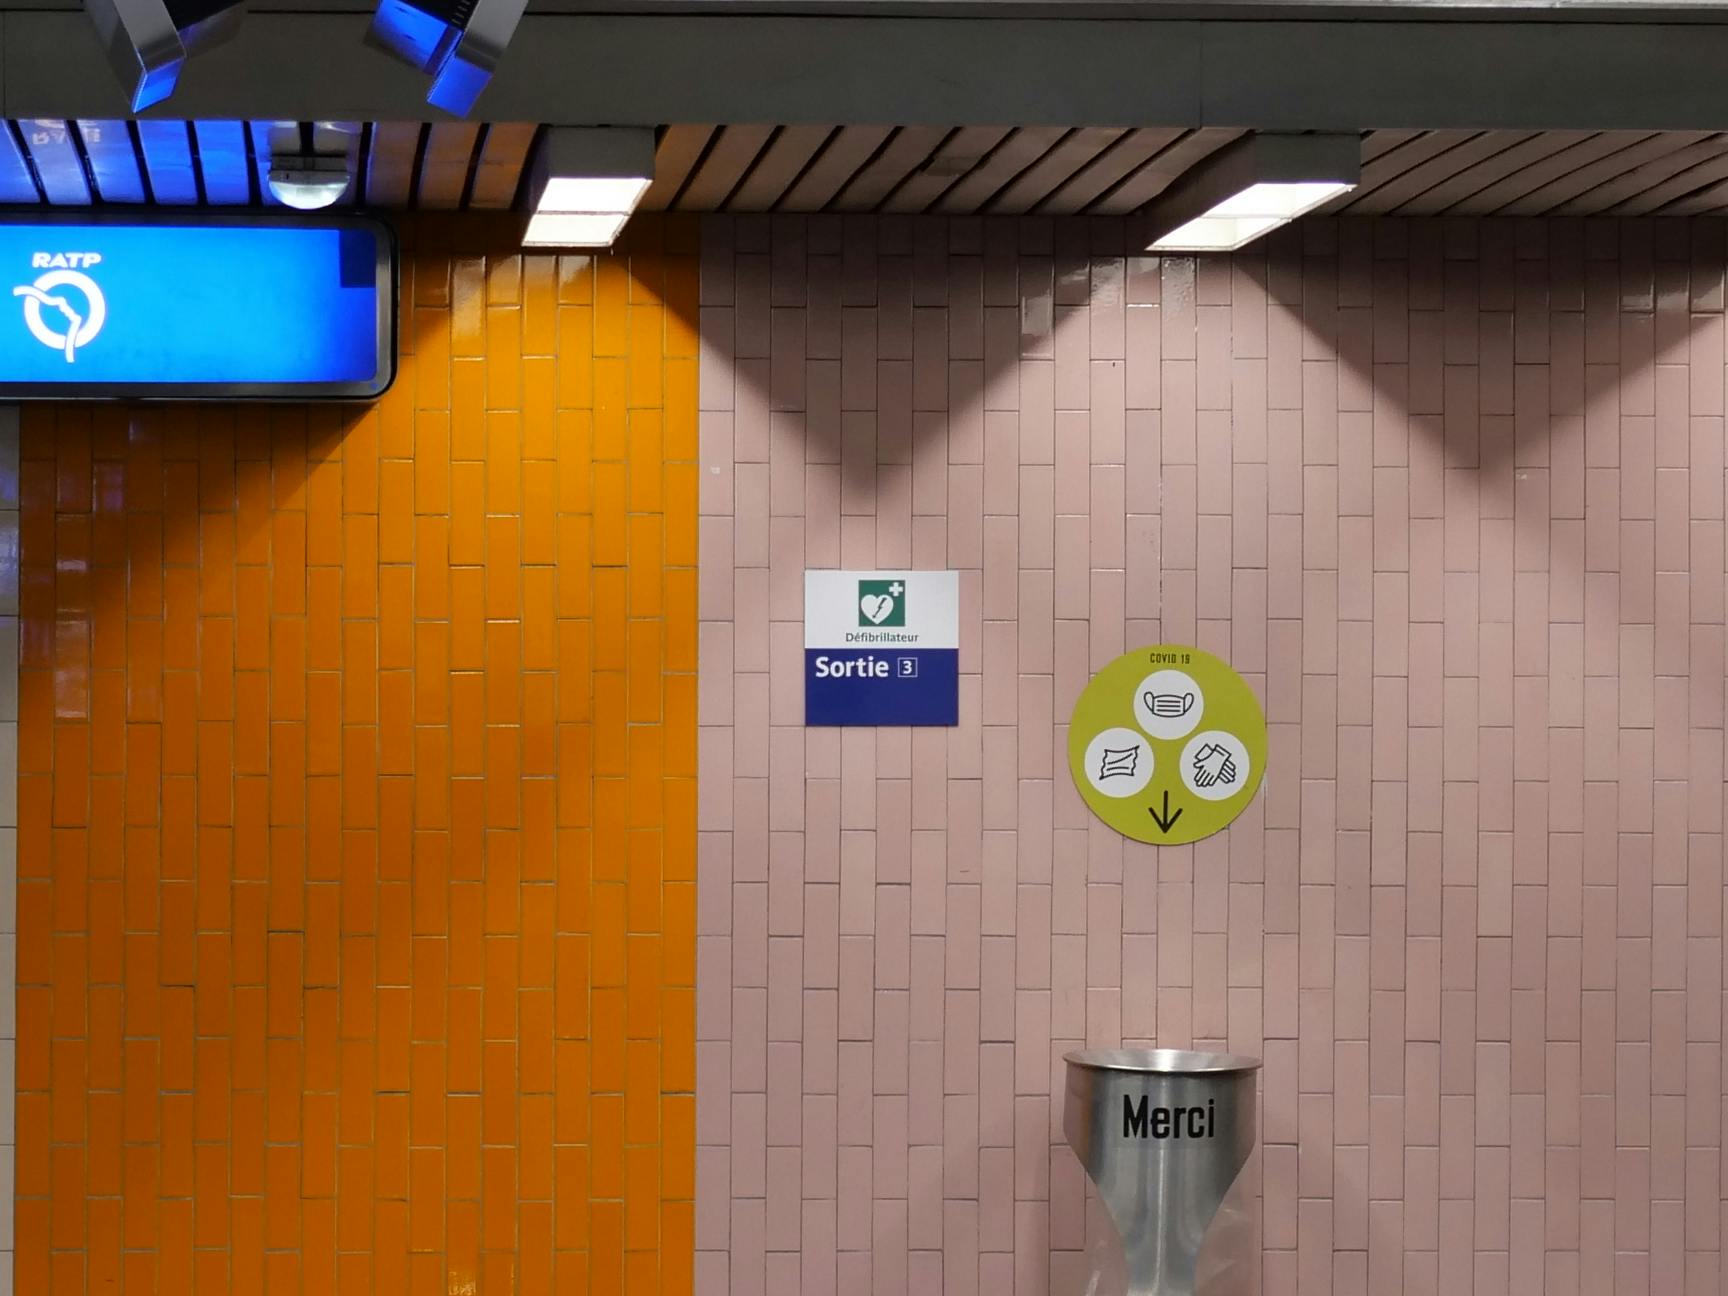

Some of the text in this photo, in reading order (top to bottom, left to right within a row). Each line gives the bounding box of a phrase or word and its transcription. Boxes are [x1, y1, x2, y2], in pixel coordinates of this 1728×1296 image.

[31, 251, 102, 268] RATP
[845, 632, 919, 643] Défibrillateur
[815, 656, 913, 678] Sortie 3
[1150, 653, 1191, 664] COVID 19
[1123, 1094, 1215, 1139] Merci
